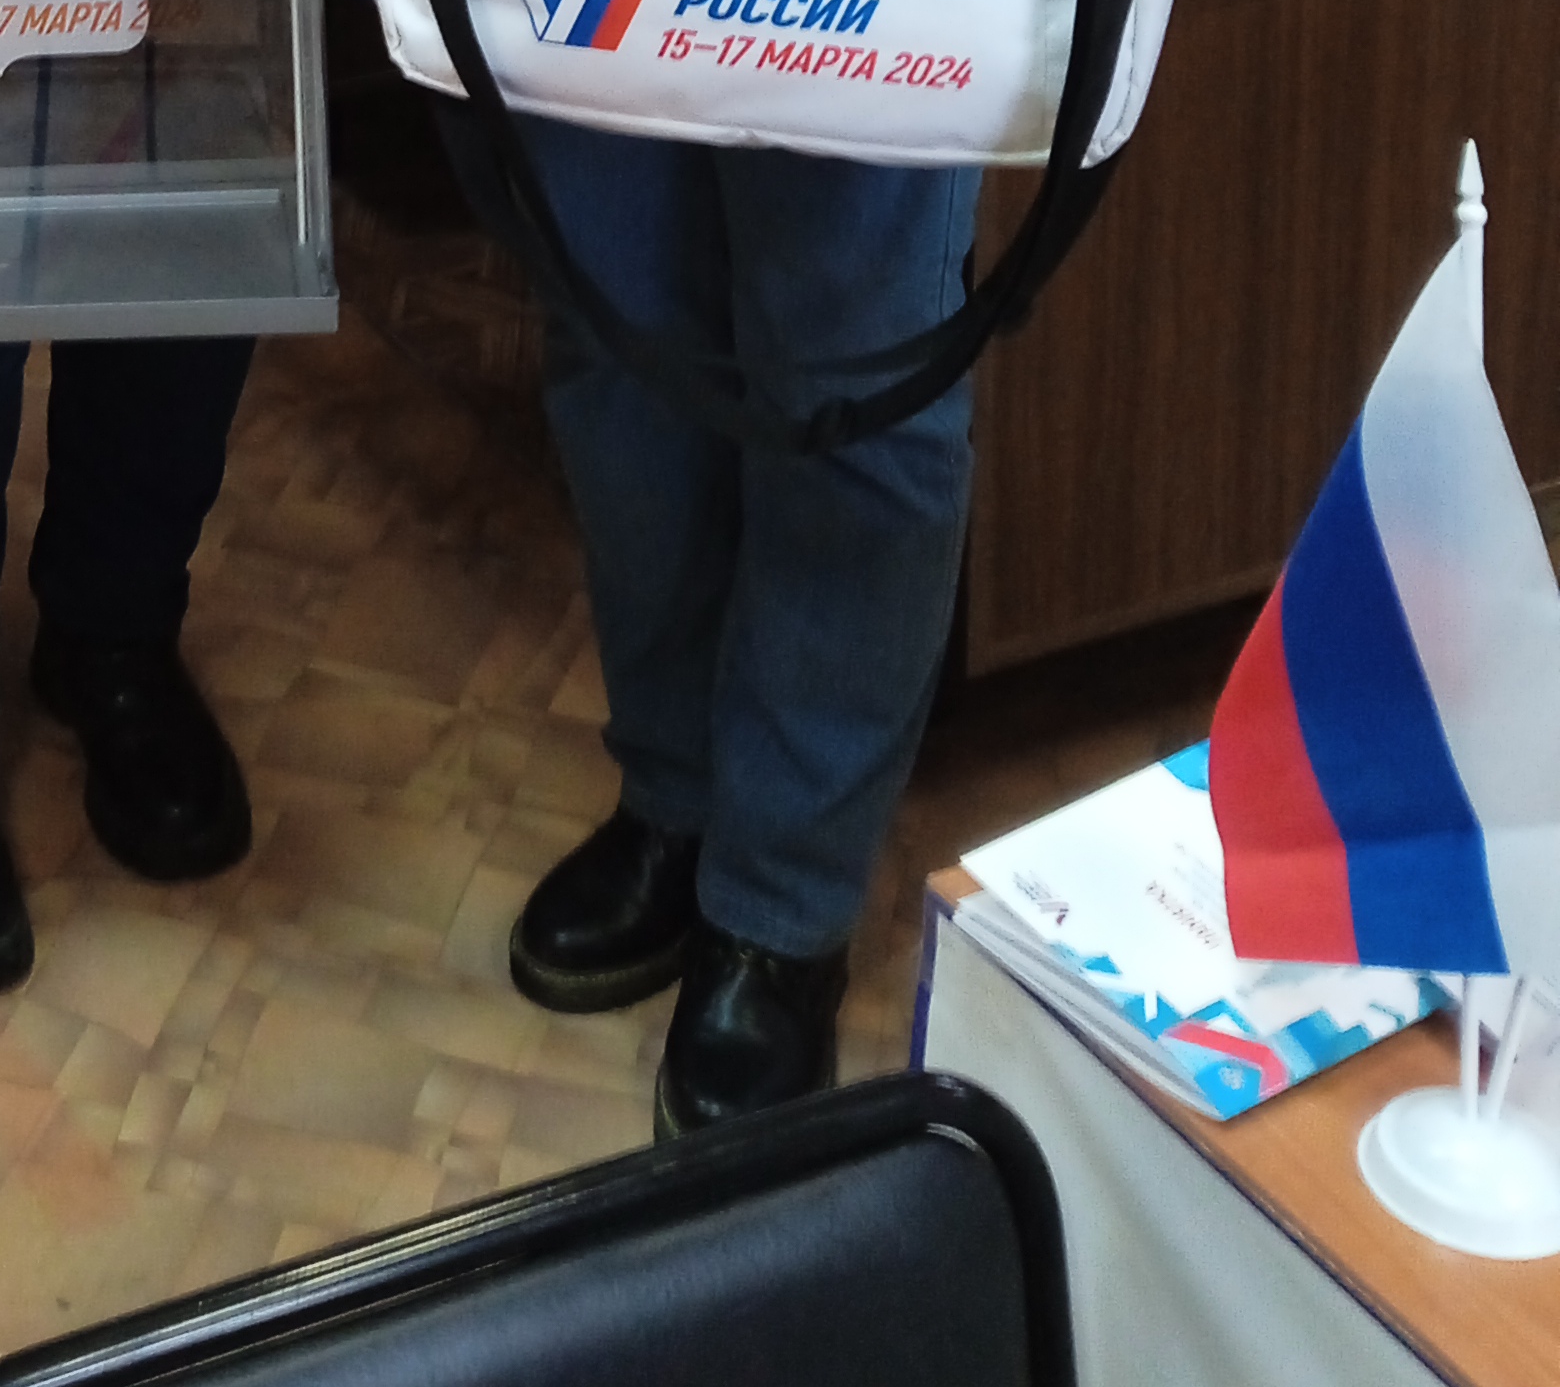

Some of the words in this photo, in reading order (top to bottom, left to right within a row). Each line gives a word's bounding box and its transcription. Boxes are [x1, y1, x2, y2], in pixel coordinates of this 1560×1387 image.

[19, 0, 124, 36] МАРТА
[756, 39, 876, 82] МАРТА
[882, 52, 974, 92] 2024
